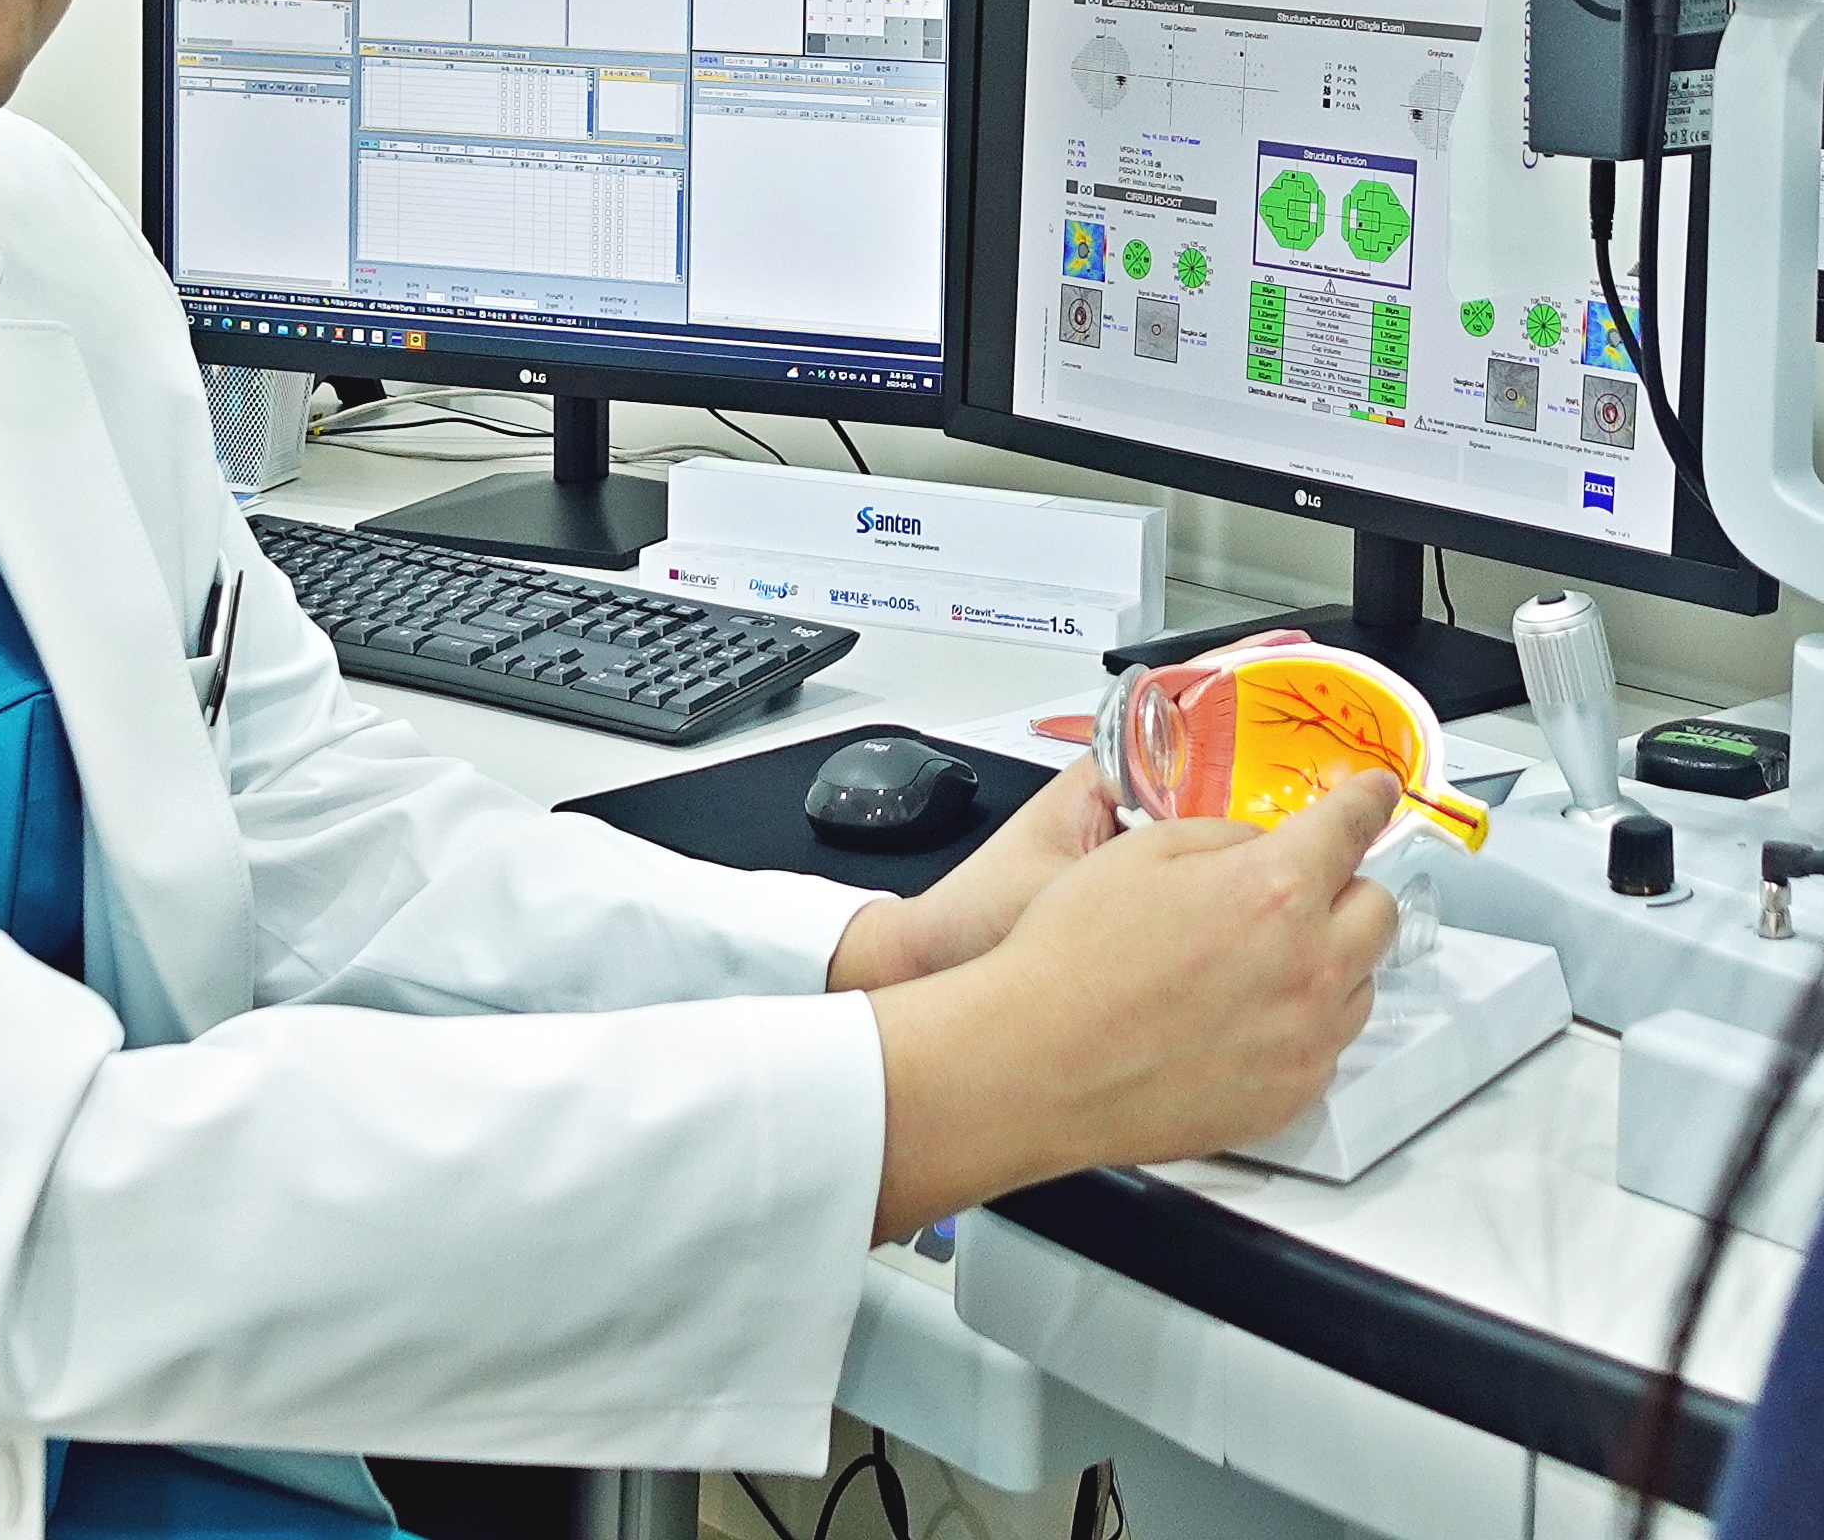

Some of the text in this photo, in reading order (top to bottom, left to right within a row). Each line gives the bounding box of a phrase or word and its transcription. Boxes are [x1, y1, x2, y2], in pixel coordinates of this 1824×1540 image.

[1146, 0, 1178, 12] Threshold
[1180, 3, 1195, 14] Test
[1276, 12, 1406, 34] Structure-Function OU (Single Exam)
[1303, 149, 1368, 166] Structure Function
[1125, 191, 1183, 208] CIRRUS HD-OCT
[1264, 275, 1274, 283] OD
[532, 372, 547, 383] LG
[1308, 495, 1322, 508] LG
[856, 506, 921, 536] Santen
[874, 538, 940, 552] Imagine Your Happiness
[679, 569, 717, 586] ikervis
[790, 625, 823, 638] logi
